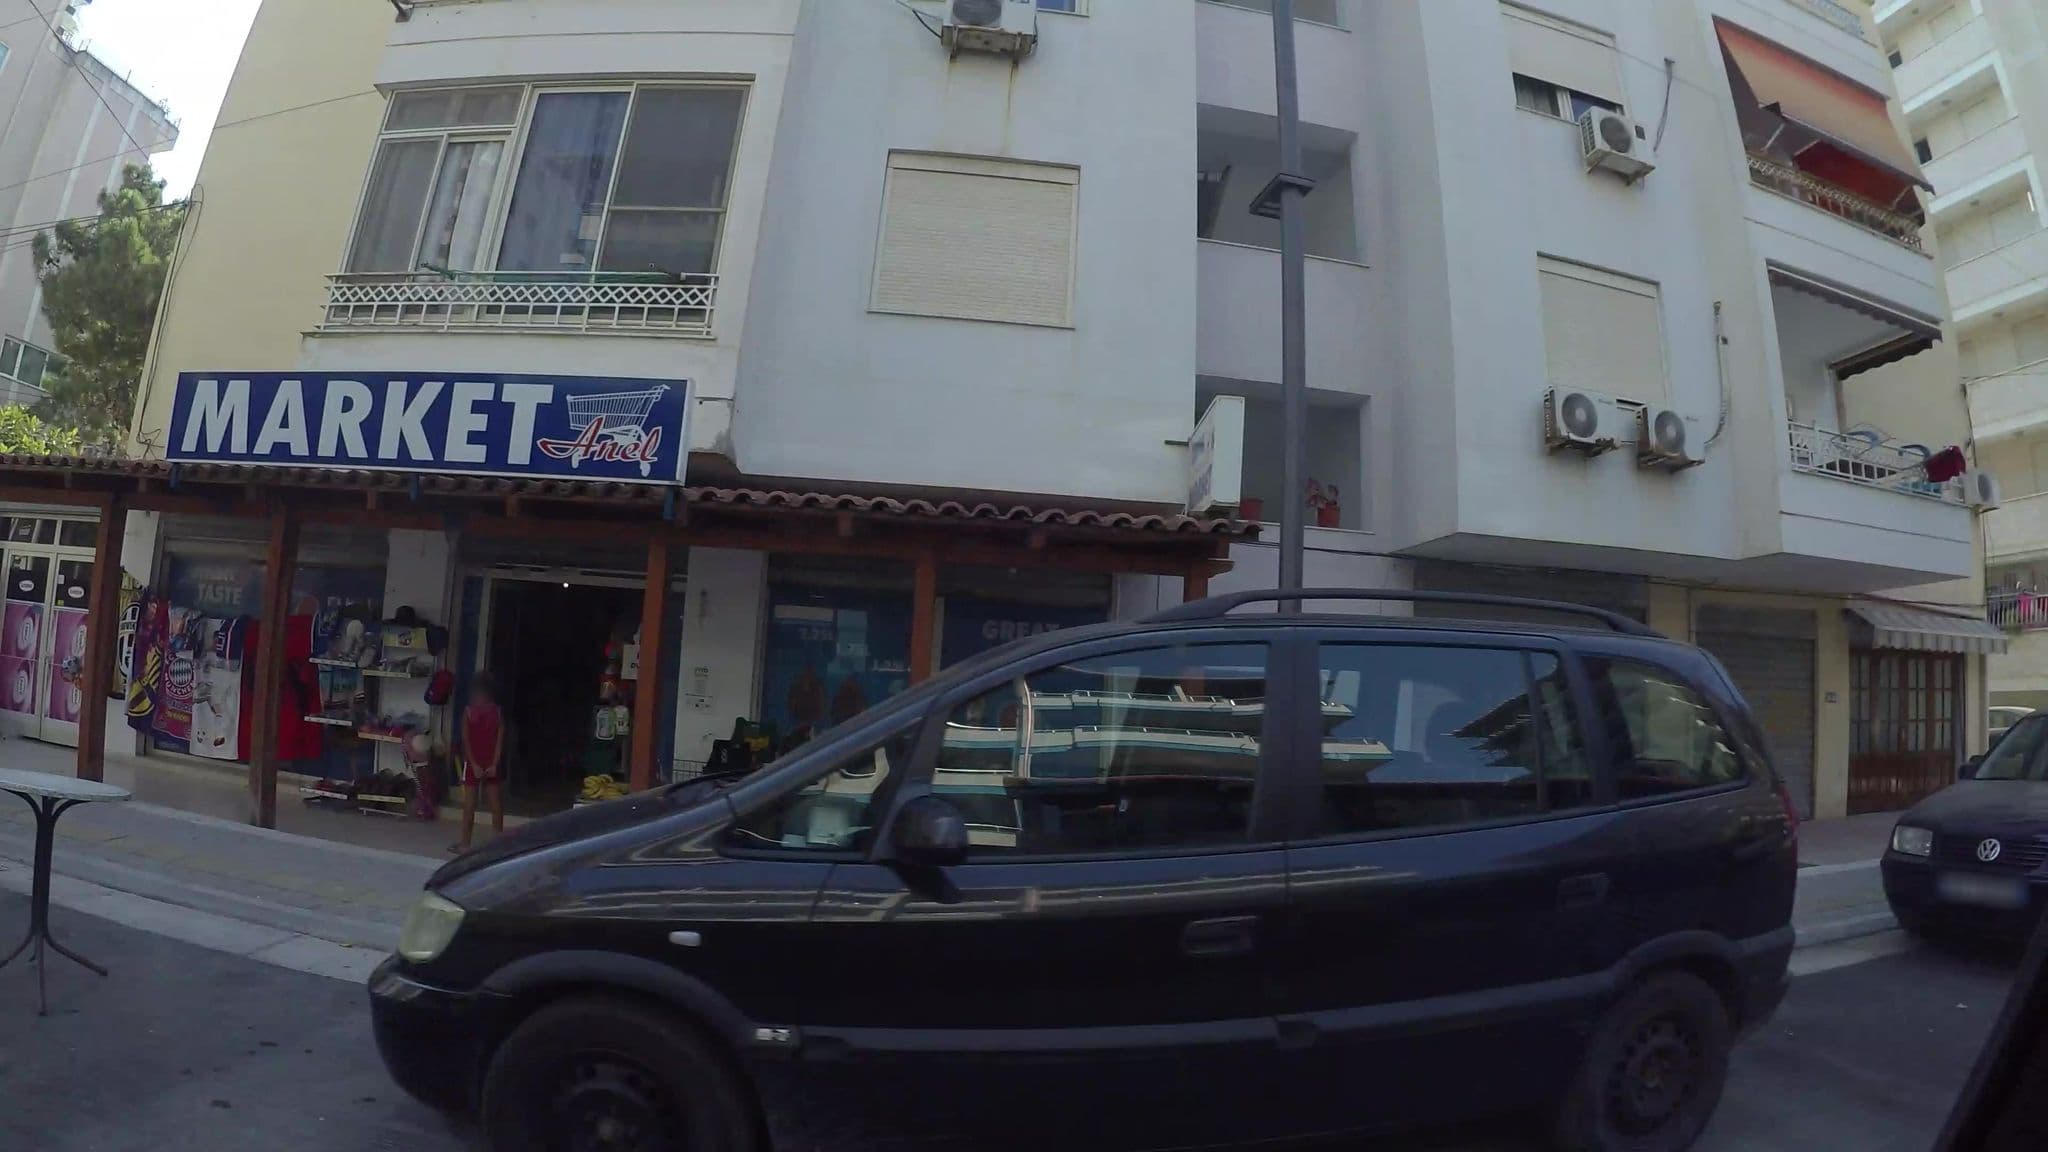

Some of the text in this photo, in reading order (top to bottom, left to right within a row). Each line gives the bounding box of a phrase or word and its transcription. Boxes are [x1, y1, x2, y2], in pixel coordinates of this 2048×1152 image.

[181, 379, 663, 465] MARKET Anel
[198, 583, 242, 605] TASTE
